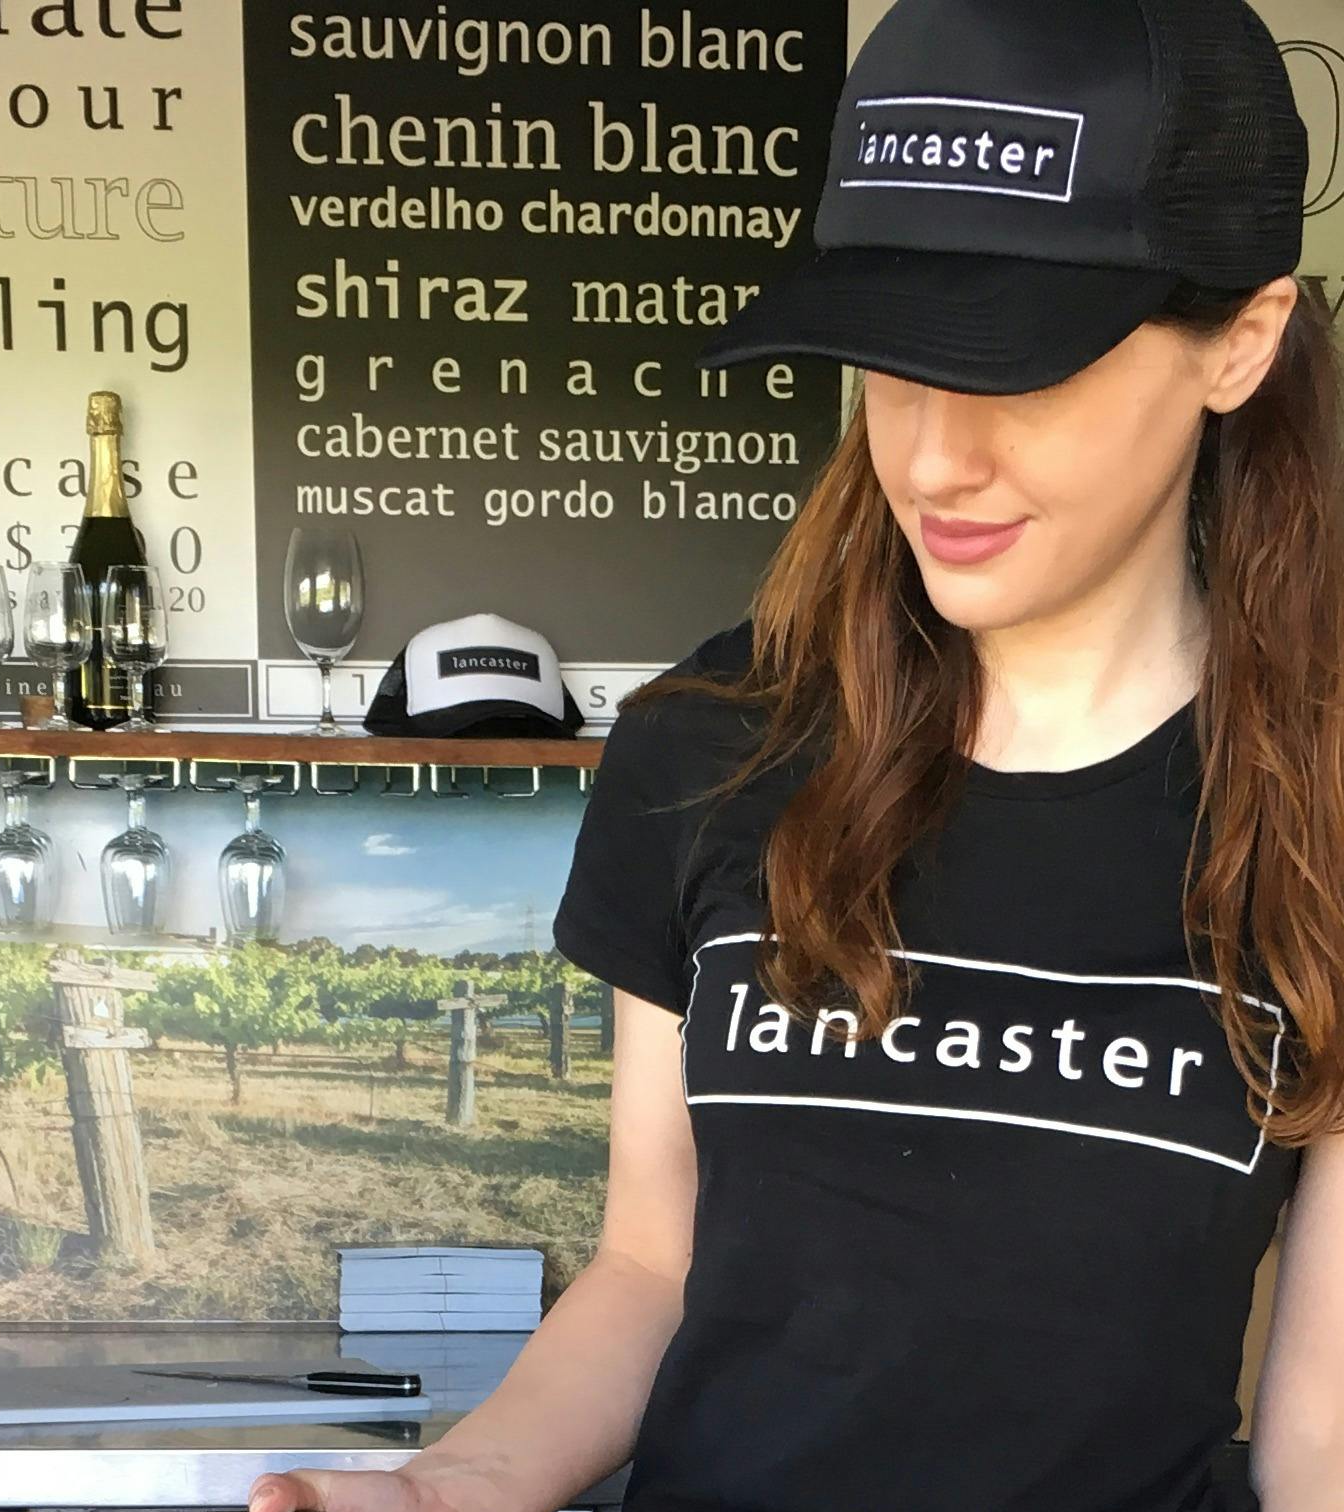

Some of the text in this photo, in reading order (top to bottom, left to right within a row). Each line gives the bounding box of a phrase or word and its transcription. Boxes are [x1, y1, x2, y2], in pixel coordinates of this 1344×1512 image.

[289, 5, 805, 76] sauvignon blanc
[8, 83, 182, 131] our
[291, 94, 799, 177] chenin blanc
[857, 121, 1055, 178] lancaster
[289, 185, 802, 249] verdelho chardonnay
[295, 258, 761, 327] shiraz matar
[295, 413, 800, 474] cabernet sauvignon
[2, 455, 199, 500] case
[296, 480, 797, 526] muscat gordo blanco
[451, 655, 529, 672] lancaster
[724, 983, 1203, 1096] lancaster
